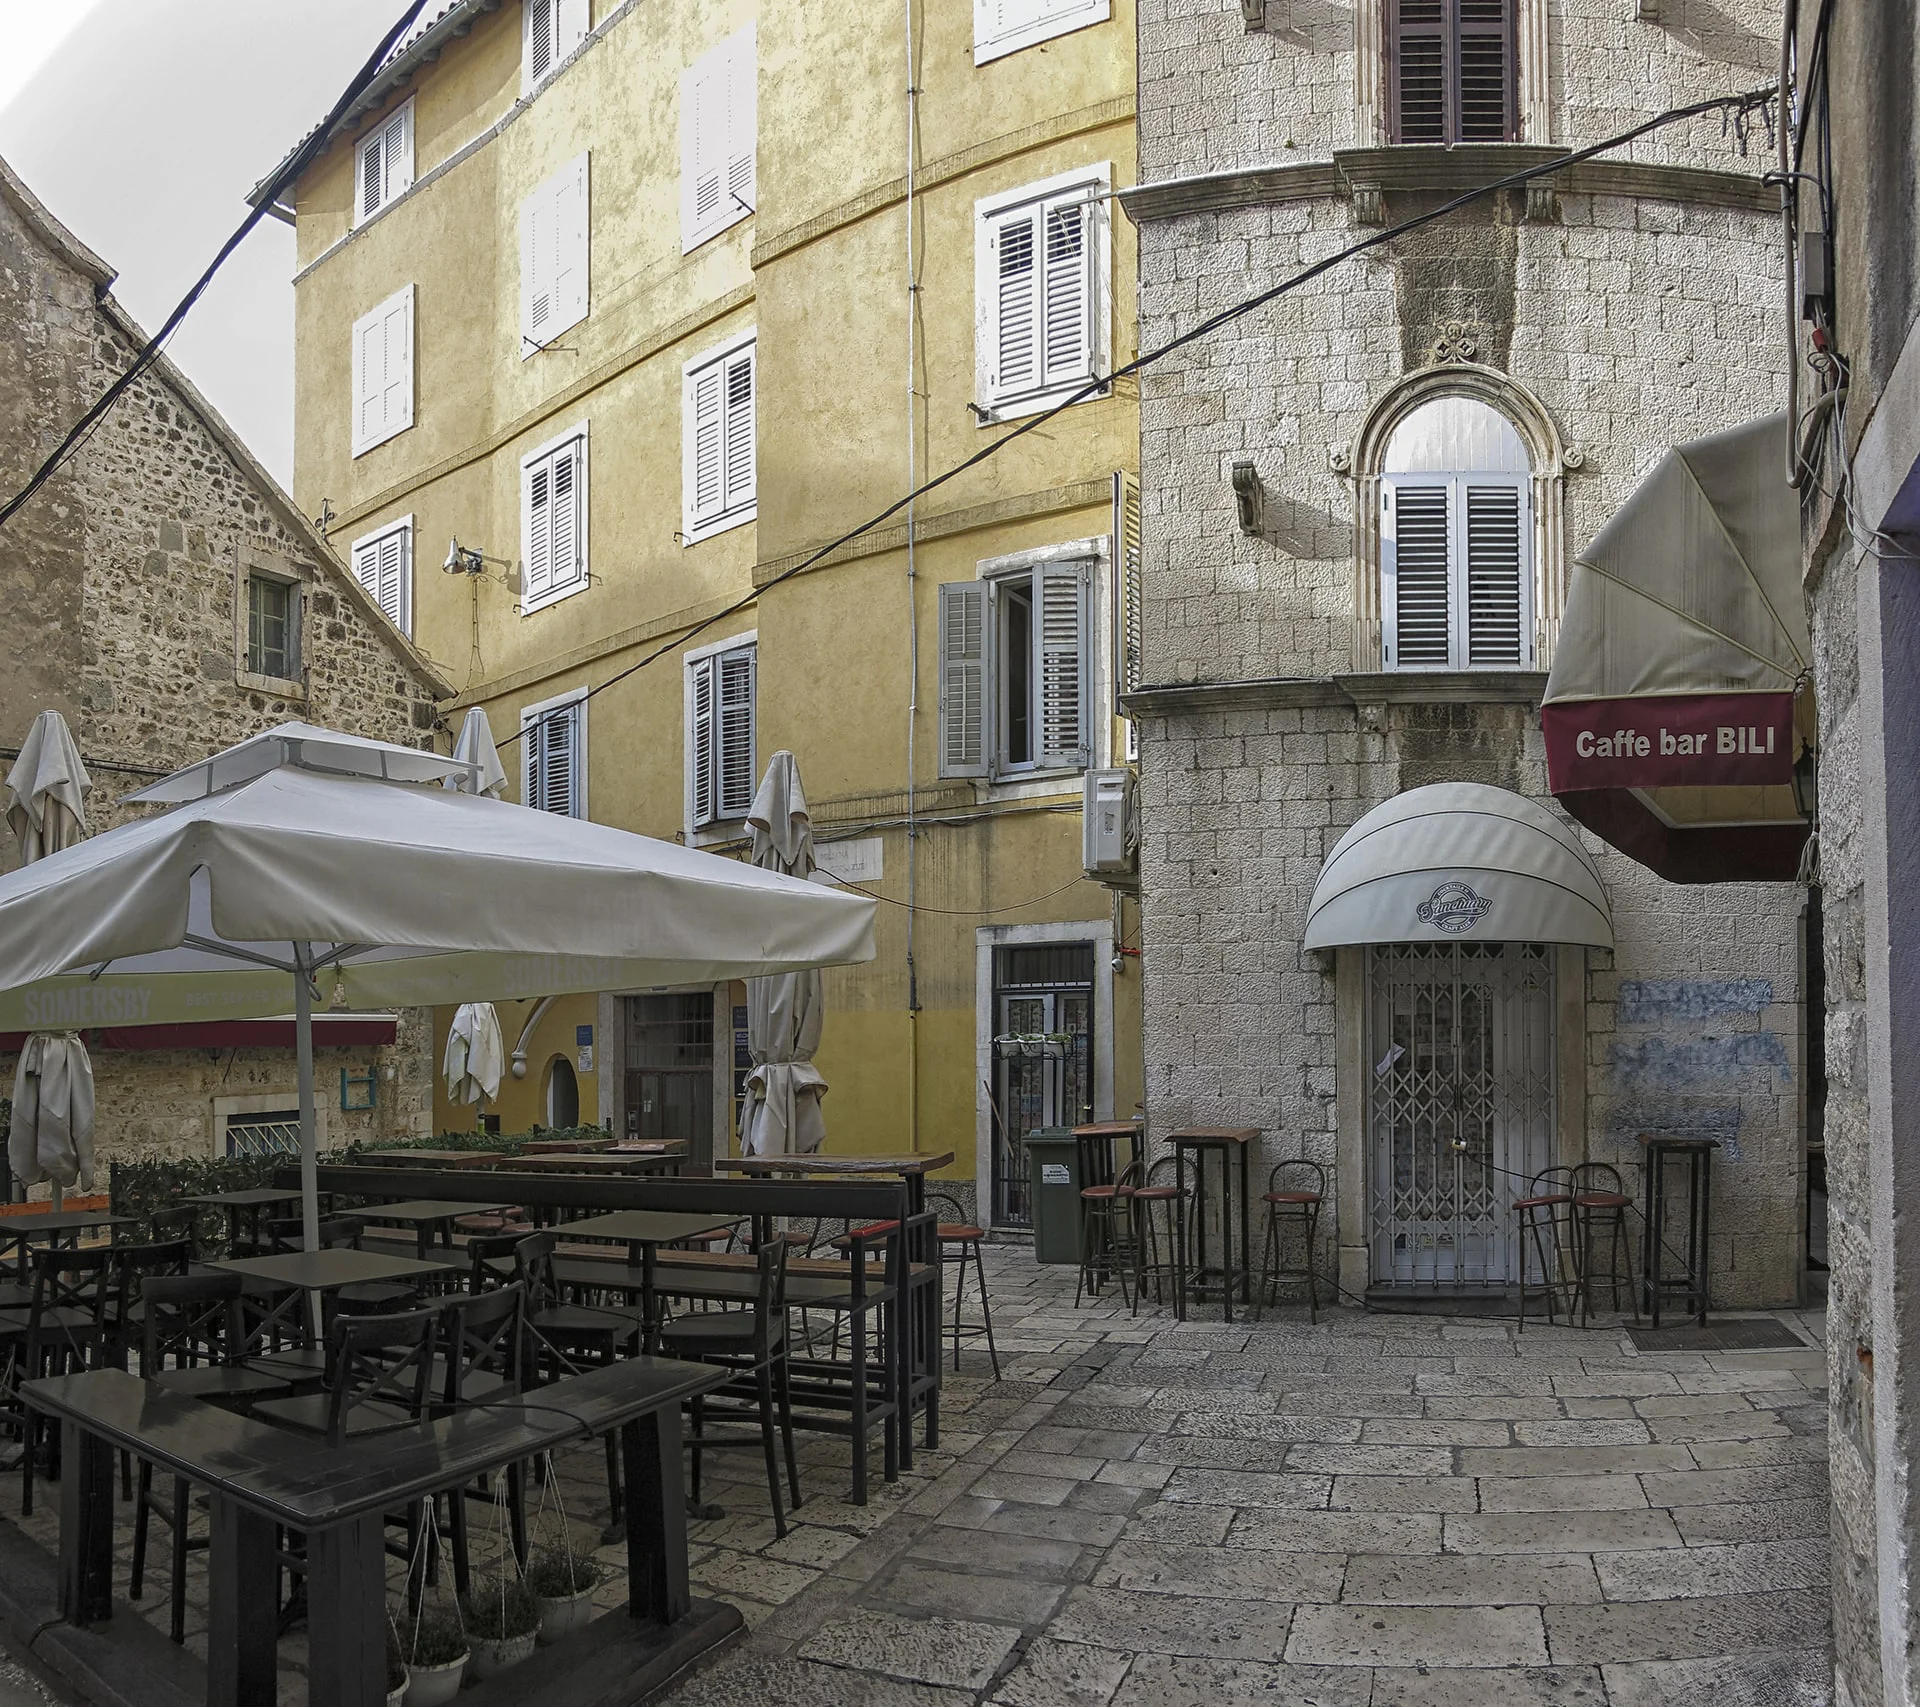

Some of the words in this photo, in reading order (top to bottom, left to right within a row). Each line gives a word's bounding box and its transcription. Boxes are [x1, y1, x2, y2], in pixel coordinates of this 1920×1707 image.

[1575, 729, 1651, 758] Caffe
[1659, 727, 1708, 756] bar
[1716, 726, 1775, 754] BILI
[24, 985, 152, 1025] SOMERSBY
